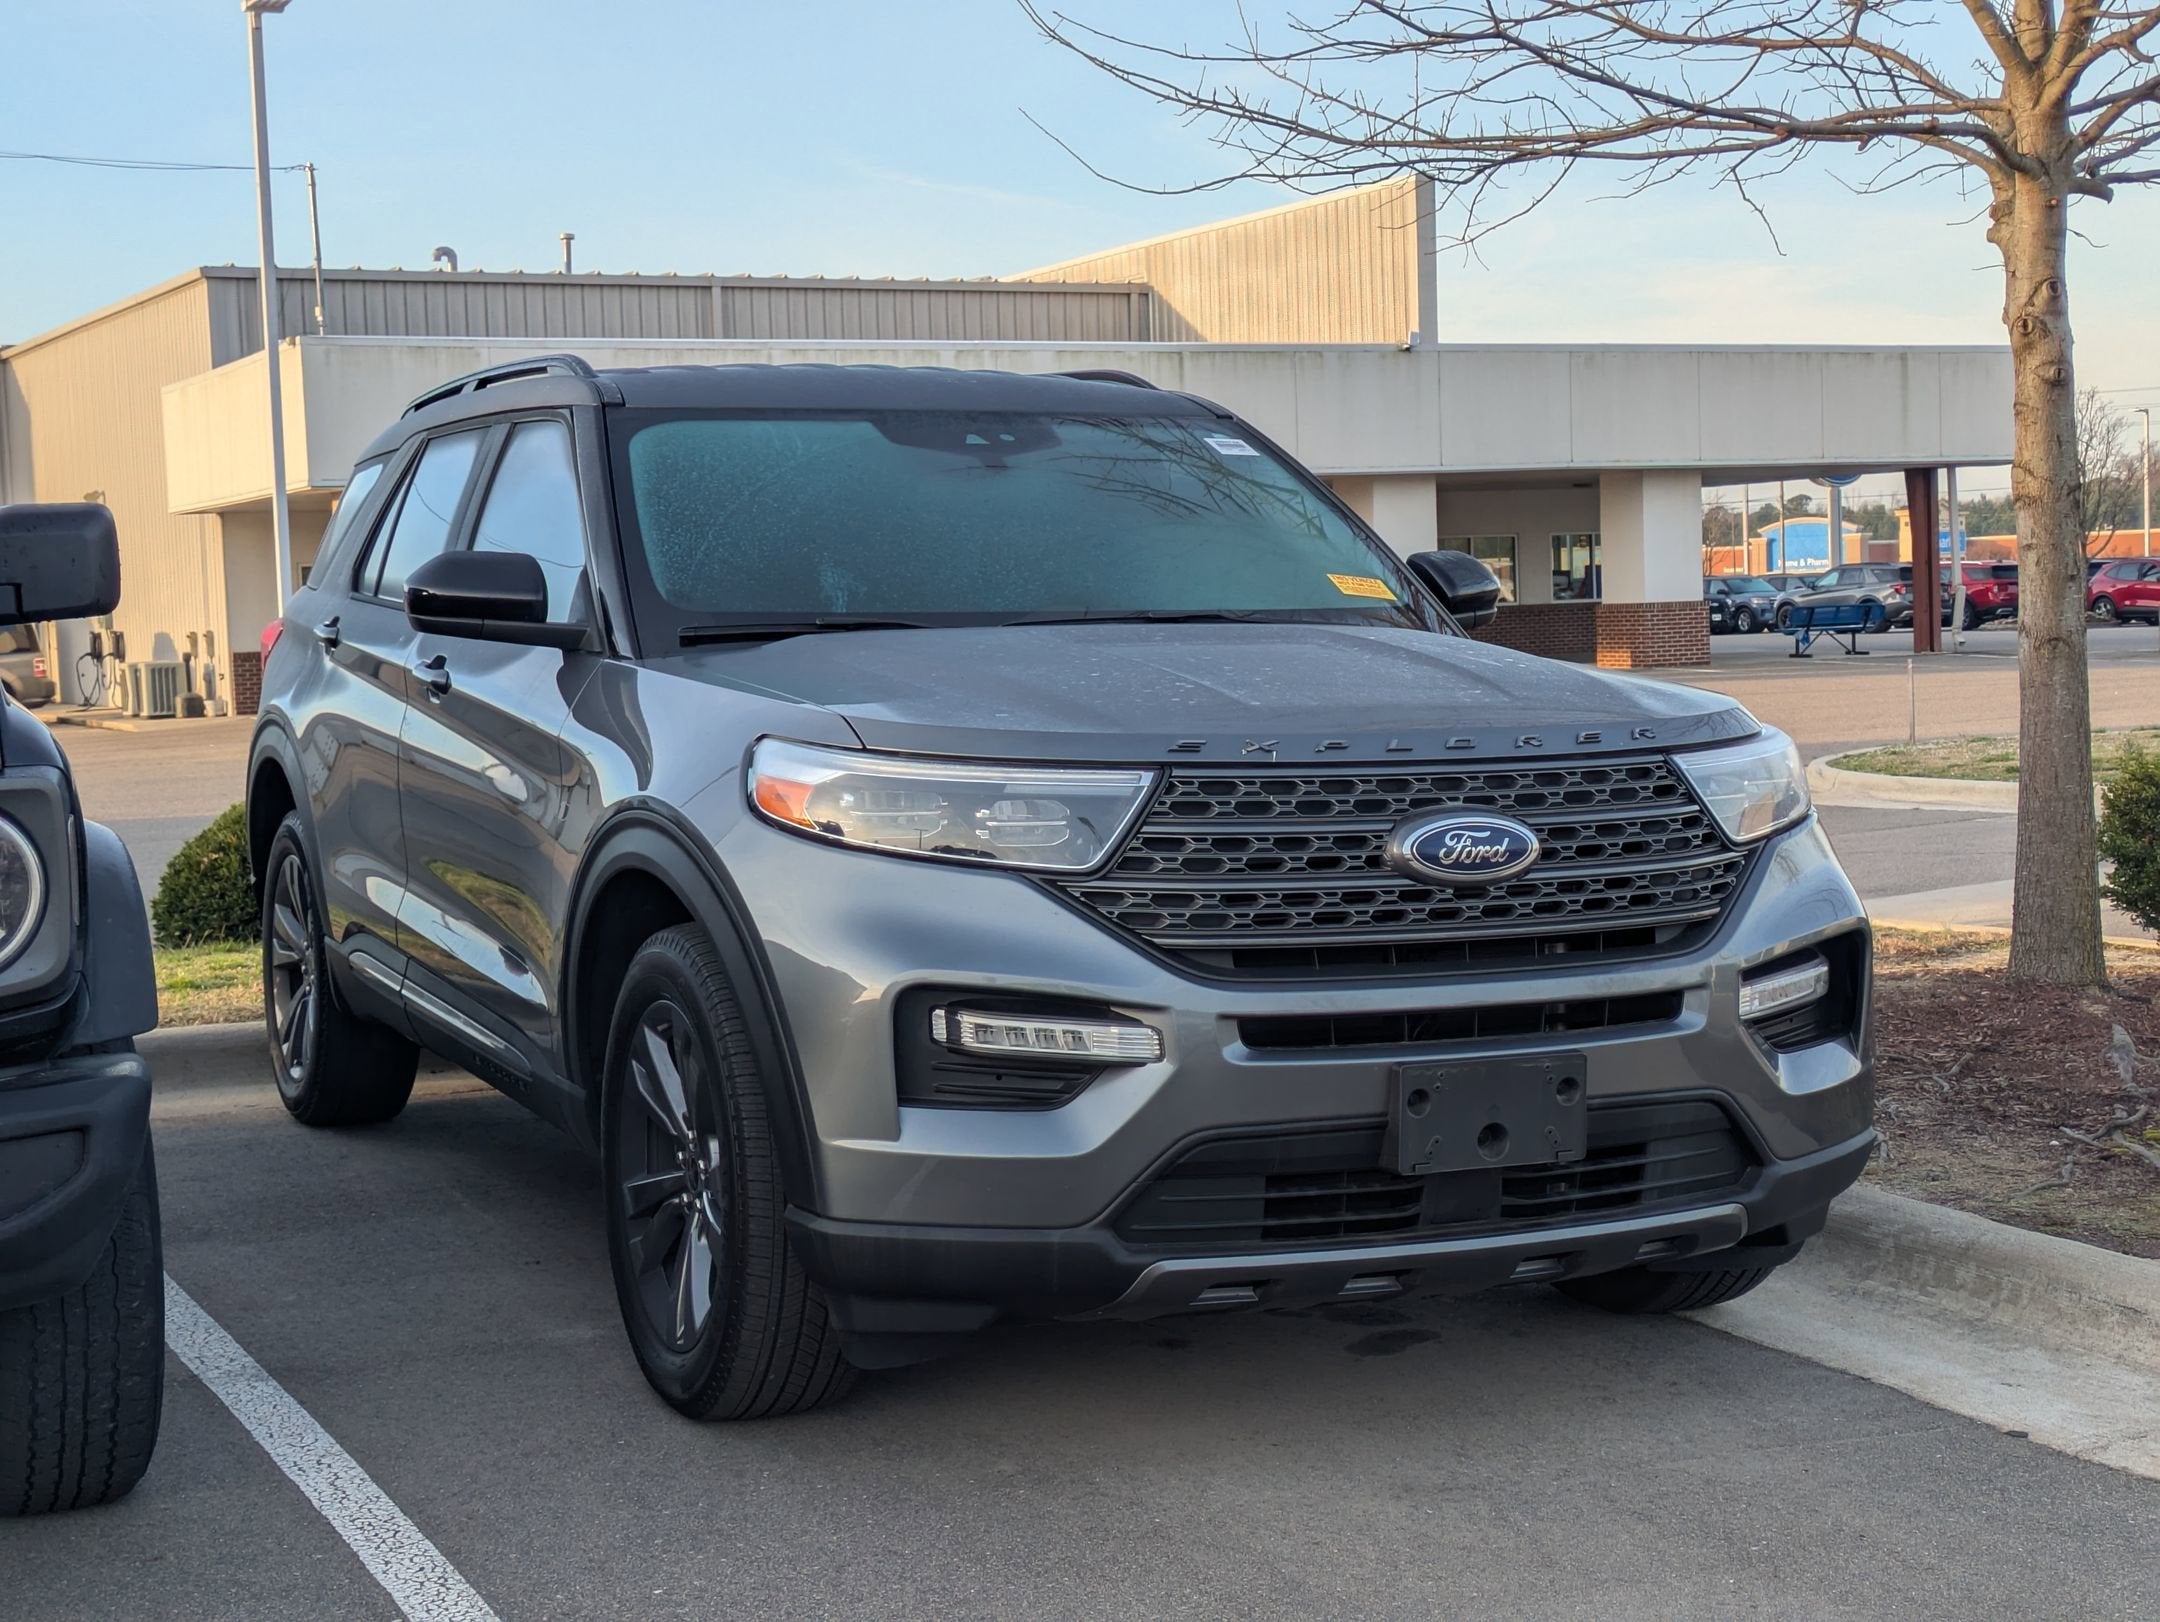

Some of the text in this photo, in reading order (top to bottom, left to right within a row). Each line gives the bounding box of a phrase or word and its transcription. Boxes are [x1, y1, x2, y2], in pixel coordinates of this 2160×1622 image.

[1800, 558, 1805, 567] &
[1807, 558, 1829, 567] Pharm
[1167, 726, 1656, 753] EXPLORER
[1439, 830, 1510, 865] Ford
